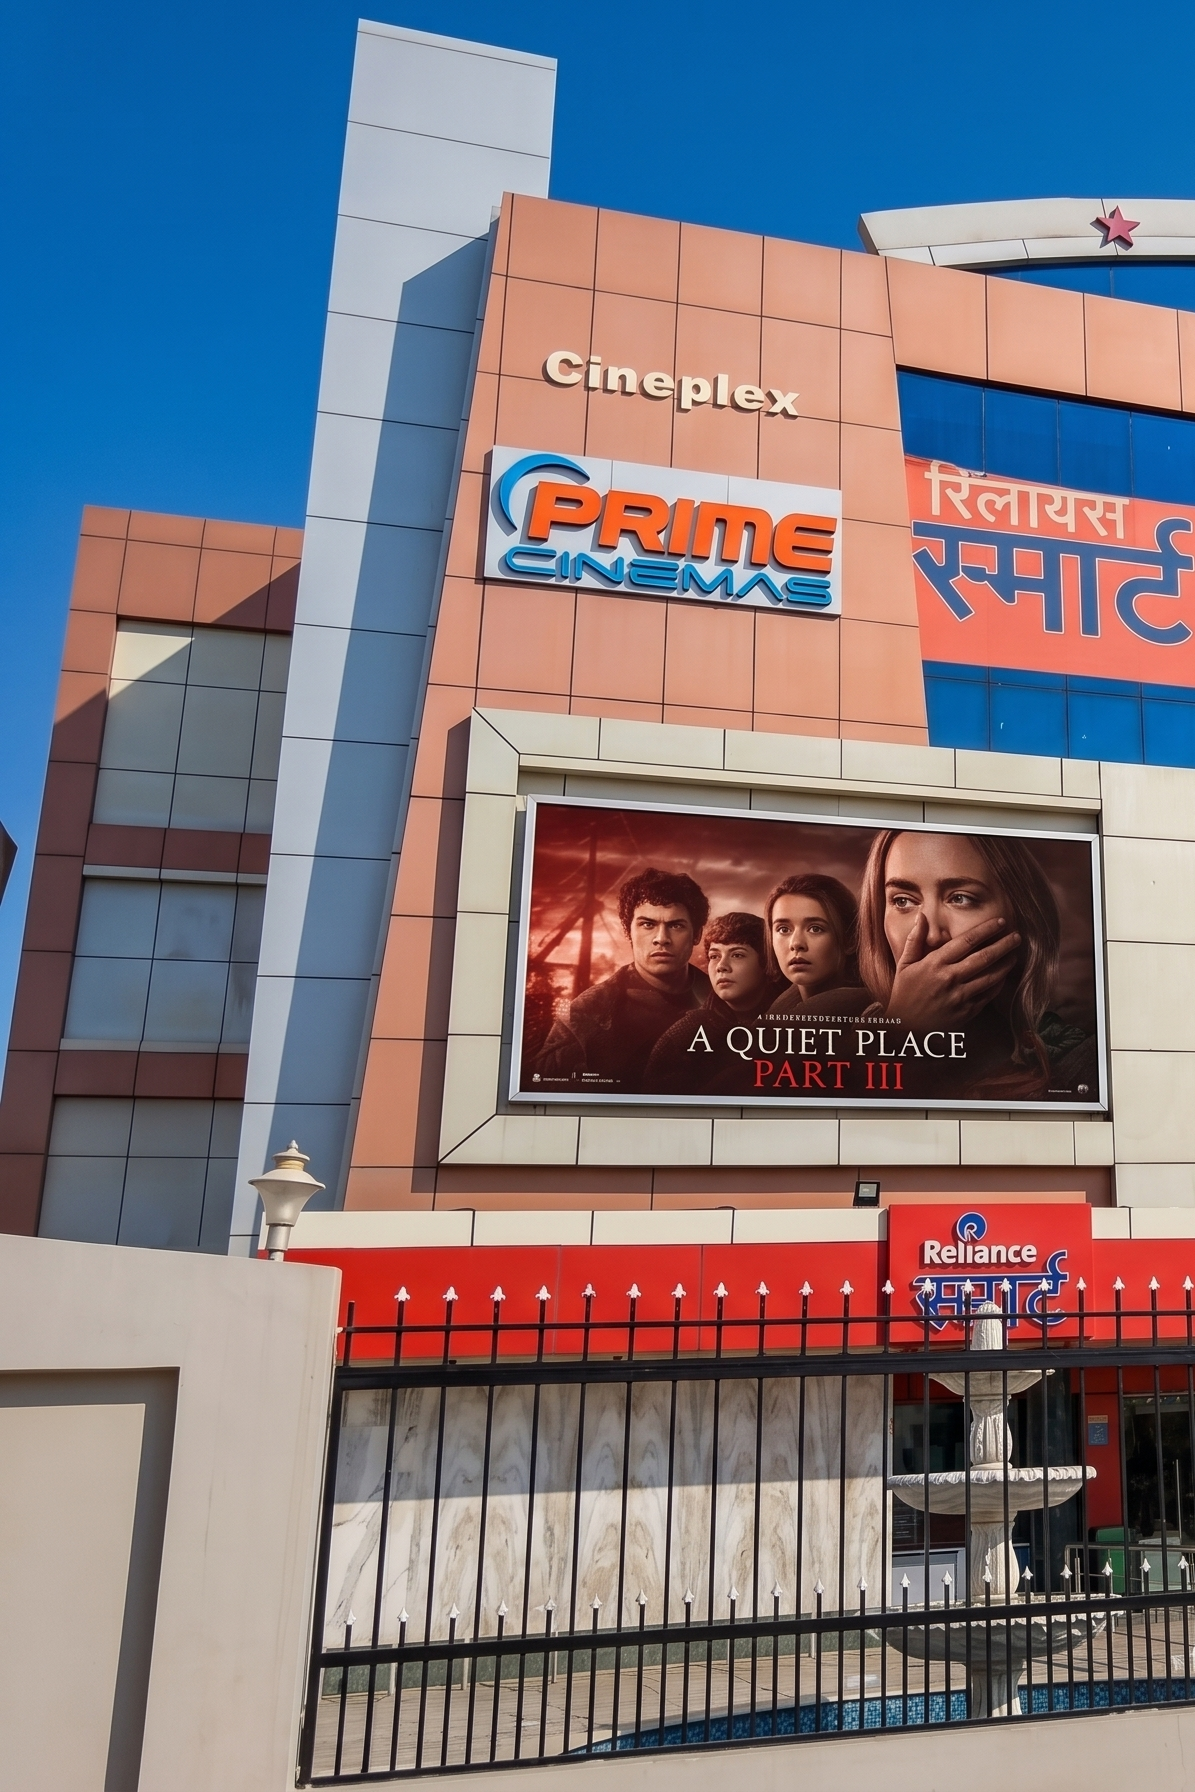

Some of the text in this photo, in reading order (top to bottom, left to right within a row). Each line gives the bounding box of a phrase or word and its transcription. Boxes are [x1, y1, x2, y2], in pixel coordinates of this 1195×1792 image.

[543, 350, 800, 417] Cineplex
[527, 480, 838, 574] PRIME
[505, 545, 832, 607] CINEMAS
[912, 517, 1195, 646] स्मार्ट
[687, 1025, 967, 1061] A QUIET PLACE
[753, 1059, 904, 1090] PART III
[923, 1240, 1037, 1264] Reliance
